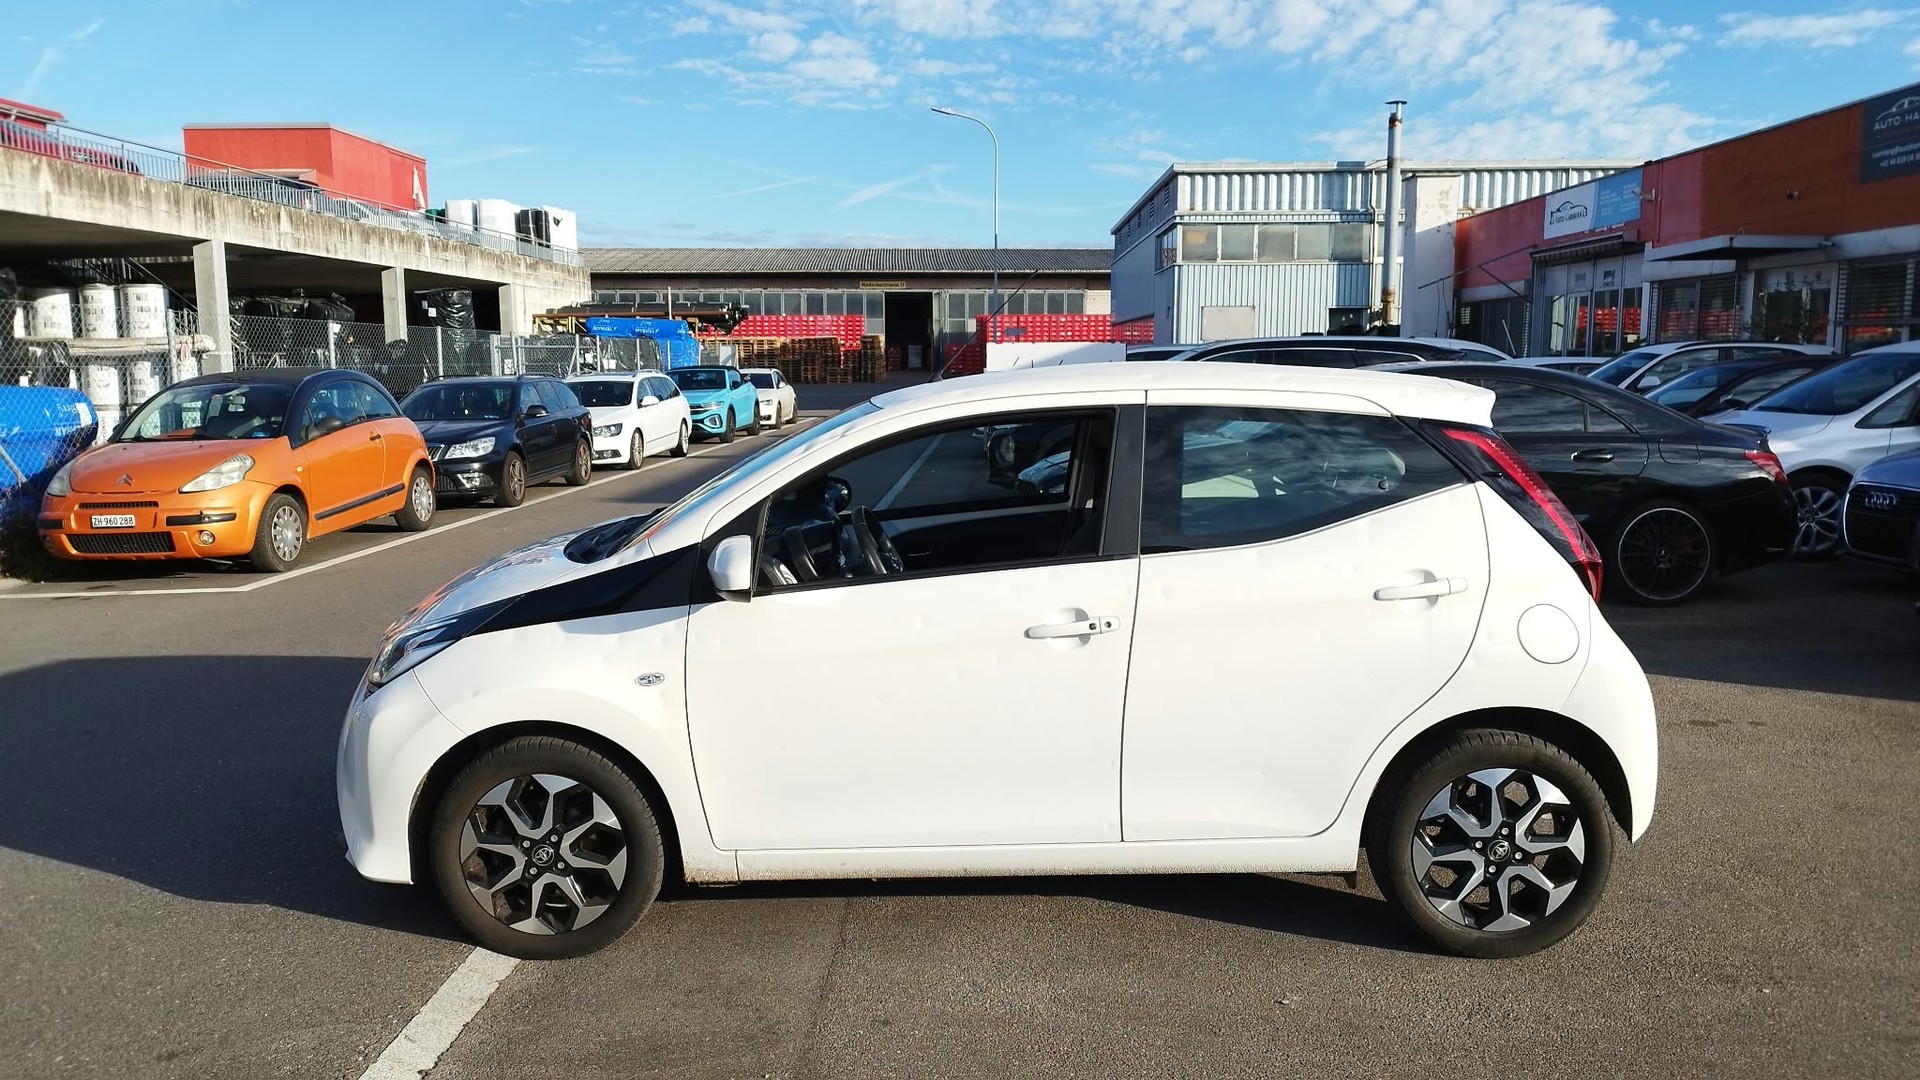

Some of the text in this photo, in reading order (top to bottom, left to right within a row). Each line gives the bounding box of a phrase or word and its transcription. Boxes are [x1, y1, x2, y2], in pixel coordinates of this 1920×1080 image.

[1874, 112, 1920, 130] AUTO HA
[93, 517, 103, 526] ZH
